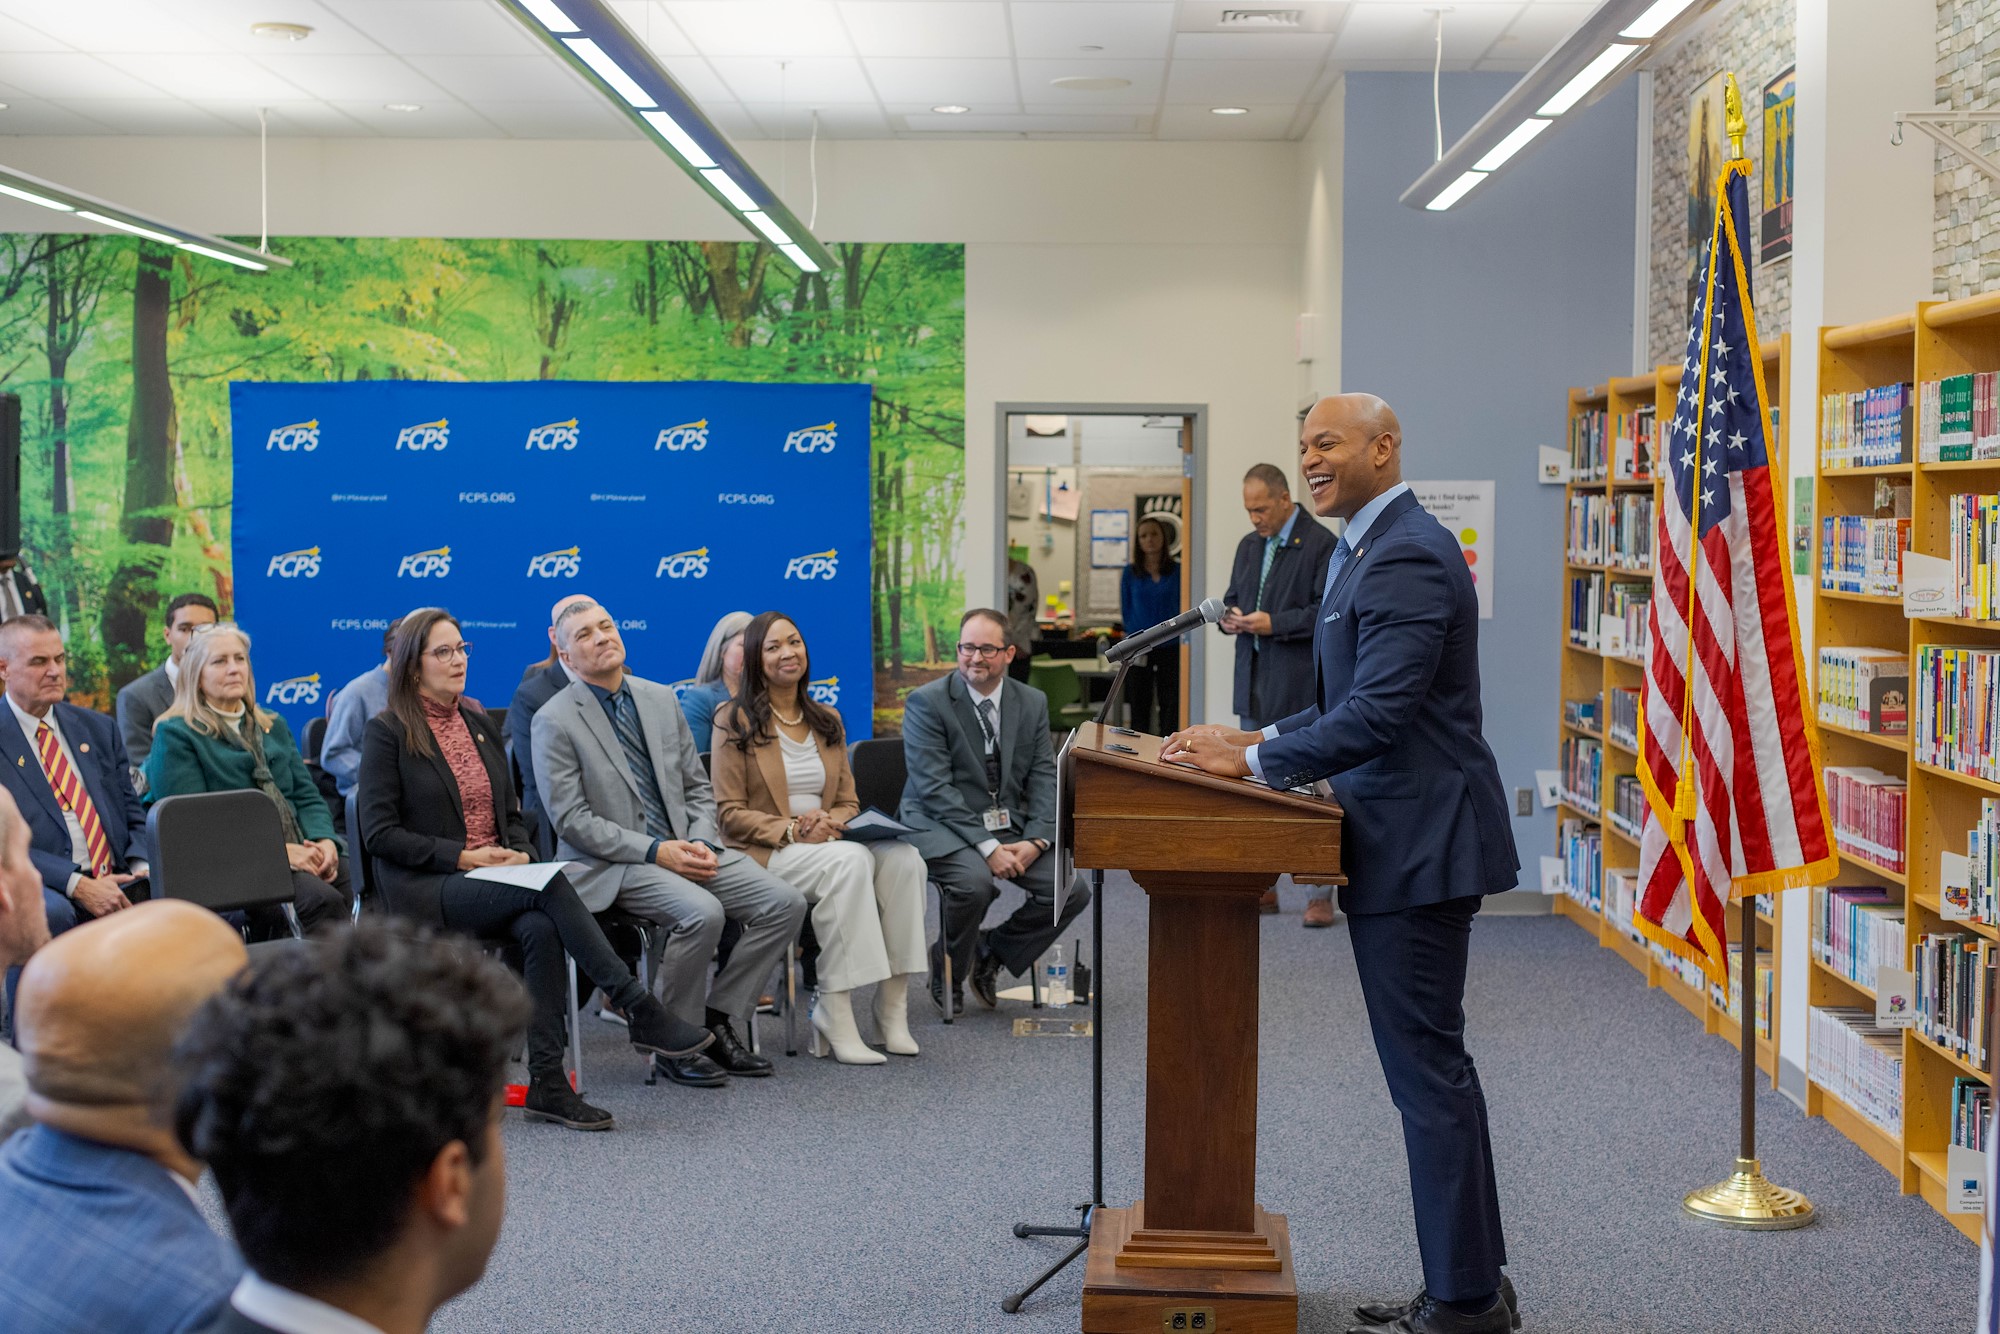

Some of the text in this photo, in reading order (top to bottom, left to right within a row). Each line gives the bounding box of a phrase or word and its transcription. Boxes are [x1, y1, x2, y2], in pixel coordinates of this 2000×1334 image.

[266, 428, 321, 452] FCPS
[395, 427, 450, 451] FCPS
[525, 427, 580, 451] FCPS
[654, 428, 709, 451] FCPS
[783, 430, 838, 453] FCPS
[459, 492, 516, 503] FCPS.ORG
[718, 493, 775, 504] FCPS.ORG
[266, 556, 322, 579] FCPS
[397, 555, 452, 578] FCPS
[527, 555, 582, 578] FCPS
[656, 556, 710, 579] FCPS
[785, 558, 839, 581] FCPS
[331, 619, 388, 630] FCPS.ORG
[266, 682, 322, 704] FCPS
